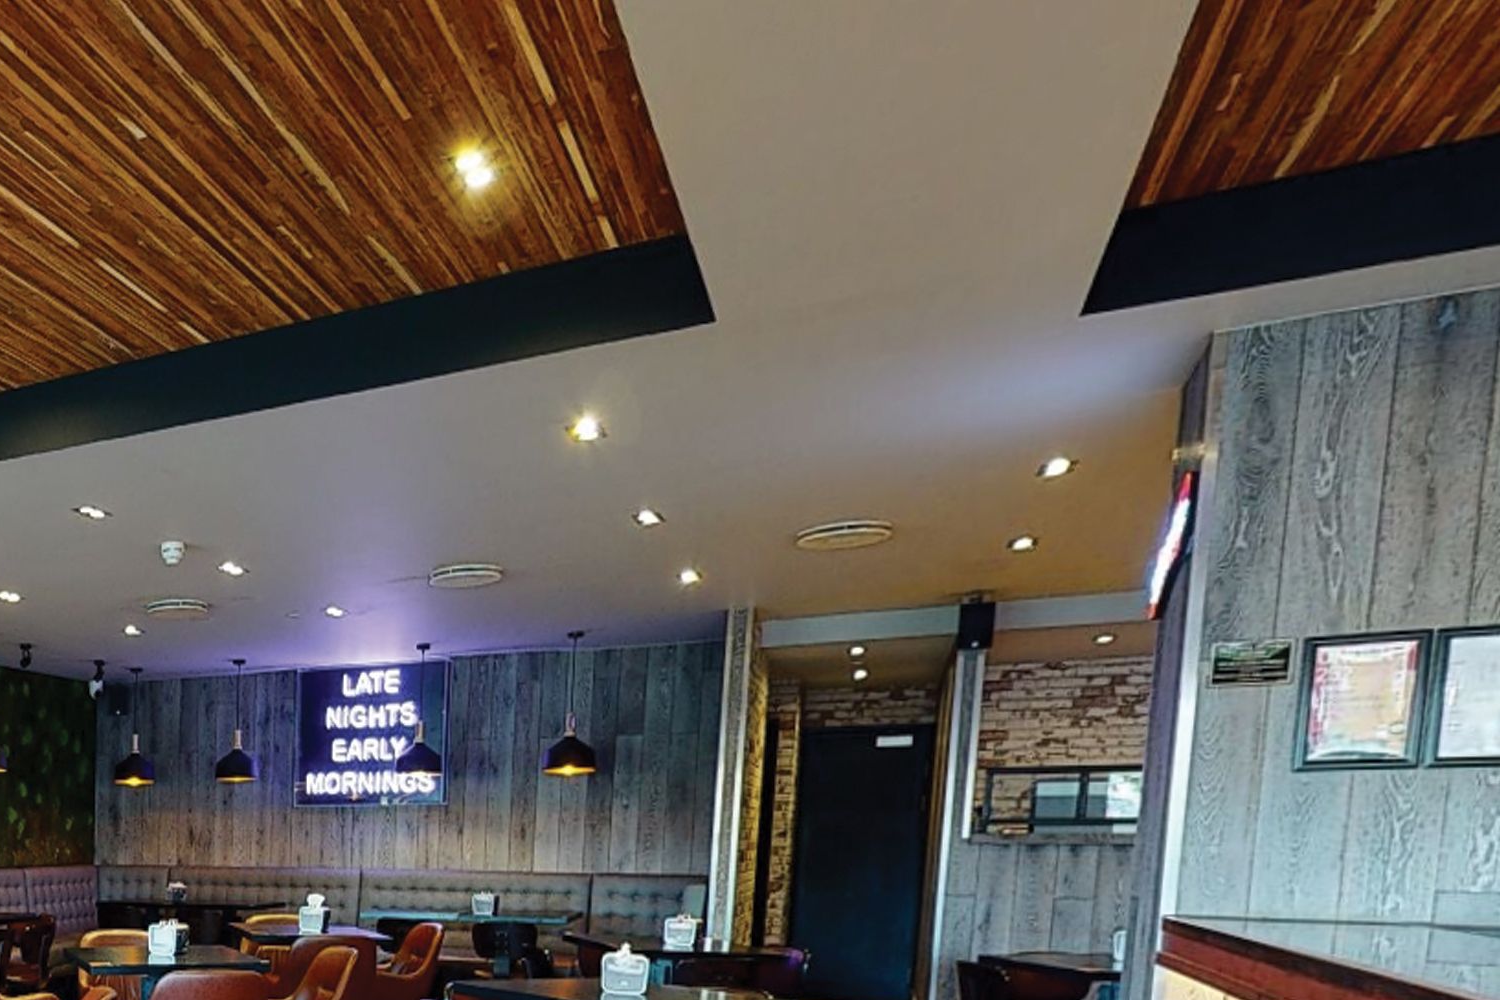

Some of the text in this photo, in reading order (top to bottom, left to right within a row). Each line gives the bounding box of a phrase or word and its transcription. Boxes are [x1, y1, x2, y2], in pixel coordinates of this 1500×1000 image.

[342, 669, 401, 697] LATE
[326, 701, 418, 729] NIGHTS
[332, 736, 406, 762] EARLY
[306, 771, 436, 795] MORNINGS
